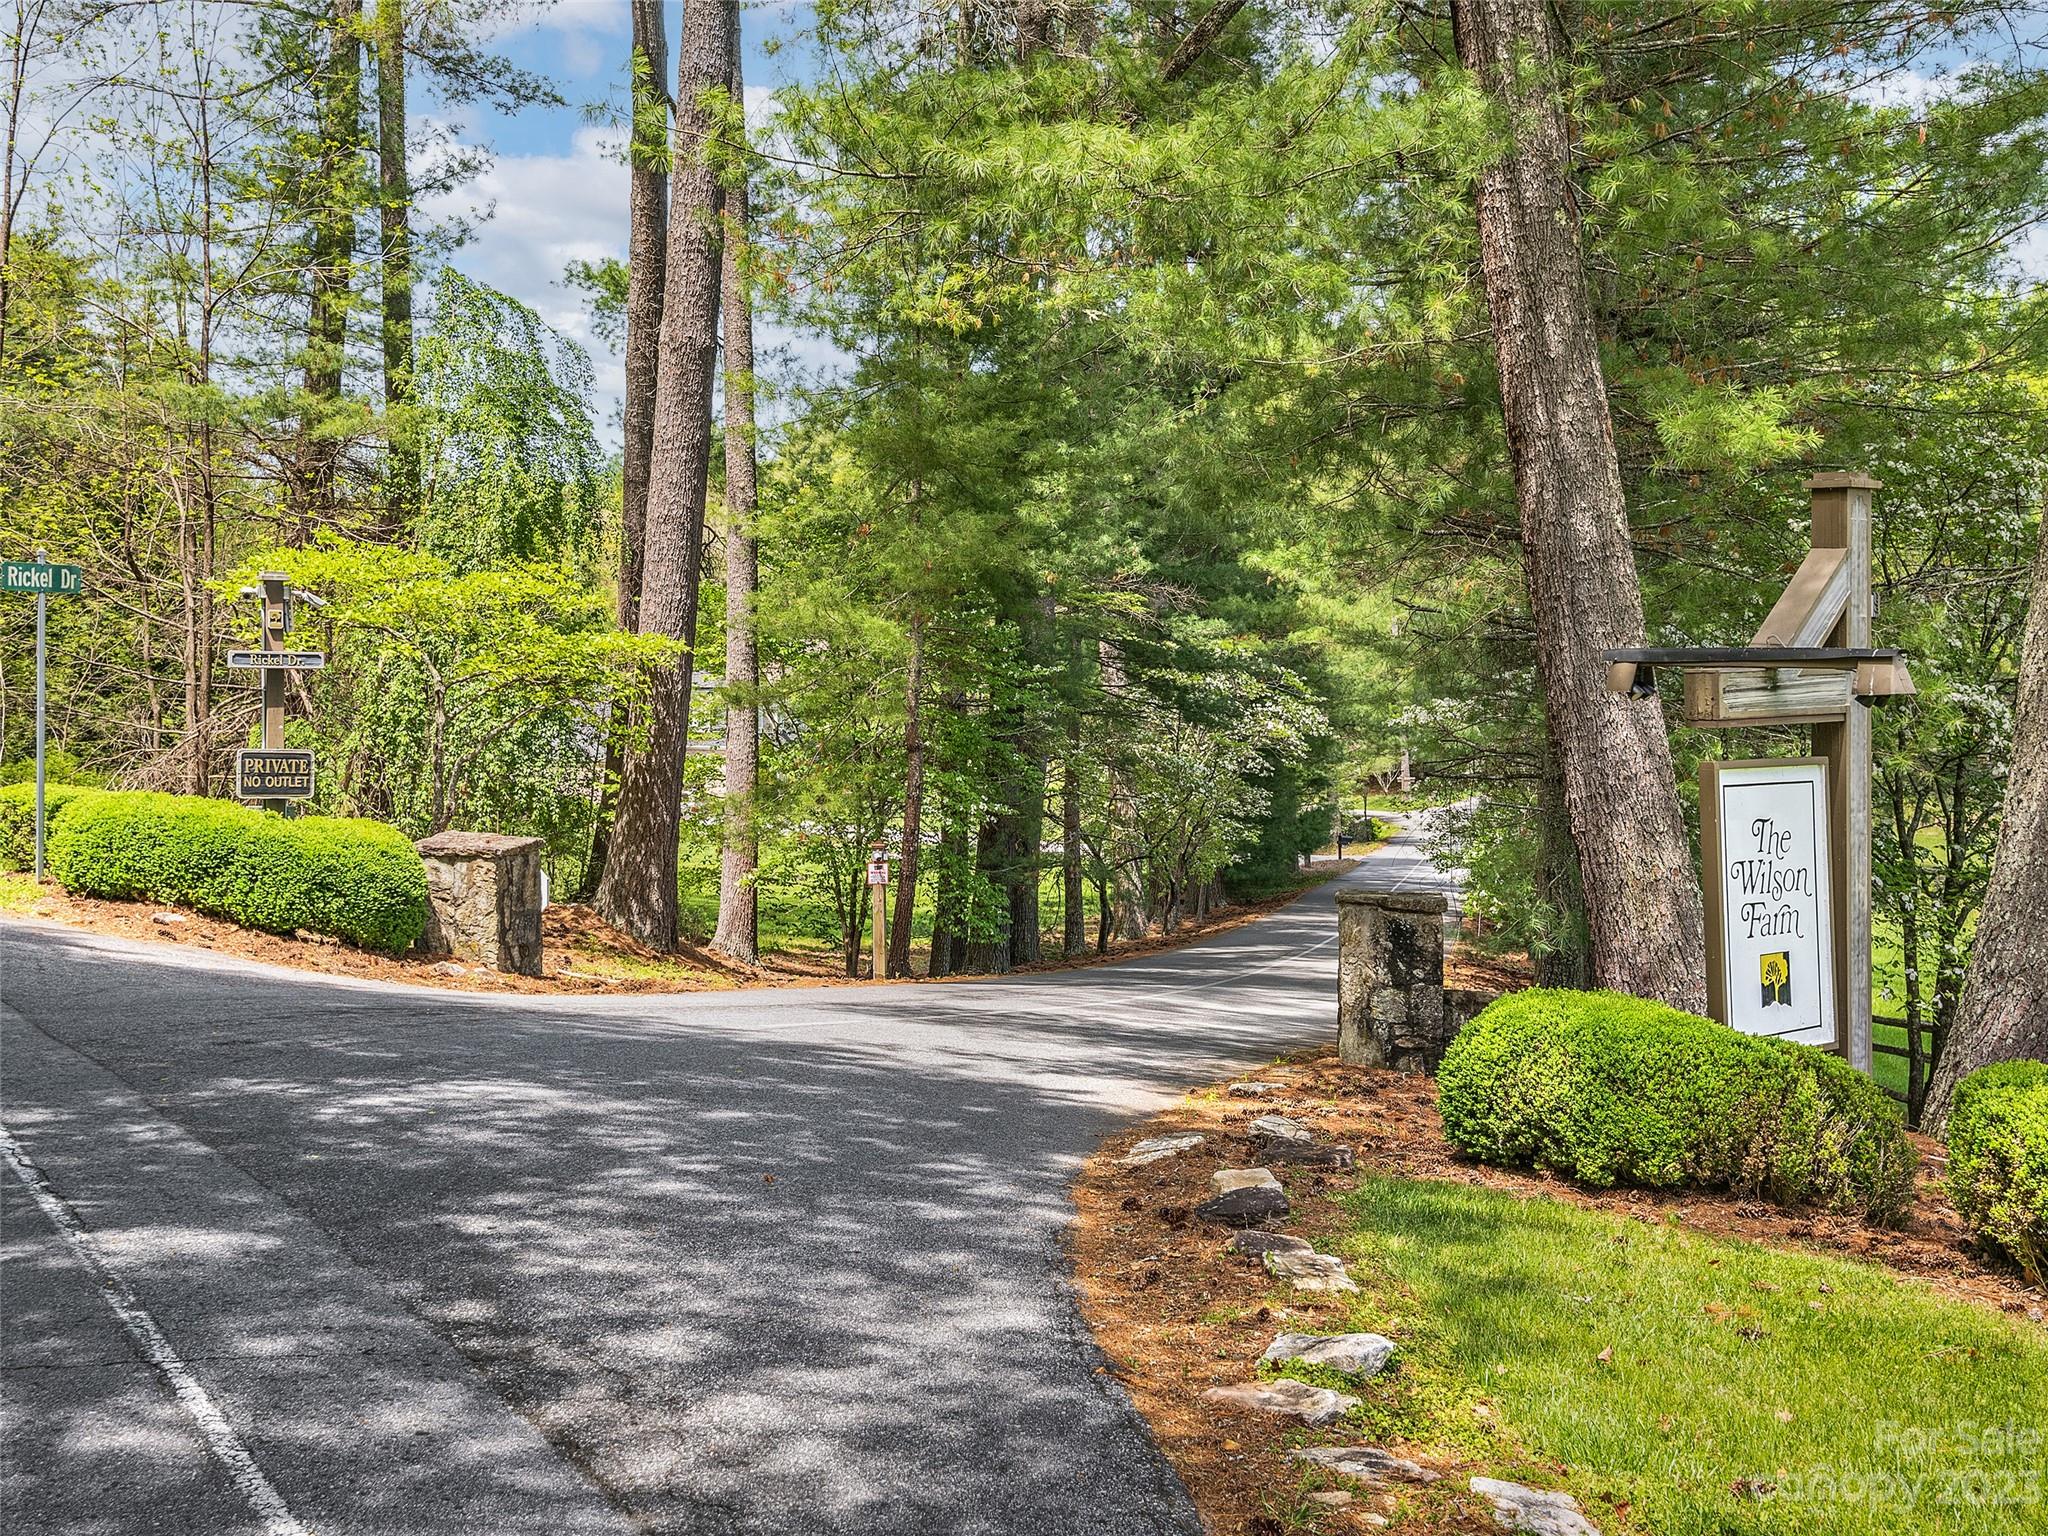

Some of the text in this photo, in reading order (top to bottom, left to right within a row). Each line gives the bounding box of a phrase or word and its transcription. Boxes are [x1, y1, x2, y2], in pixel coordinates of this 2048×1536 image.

[8, 566, 77, 589] Rickel Dr
[249, 654, 305, 667] Rickel Dr.
[244, 758, 309, 774] PRIVATE
[243, 776, 309, 788] NO OUTLET
[1752, 818, 1792, 860] The
[1731, 860, 1812, 901] Wilson
[1741, 902, 1804, 938] Farm
